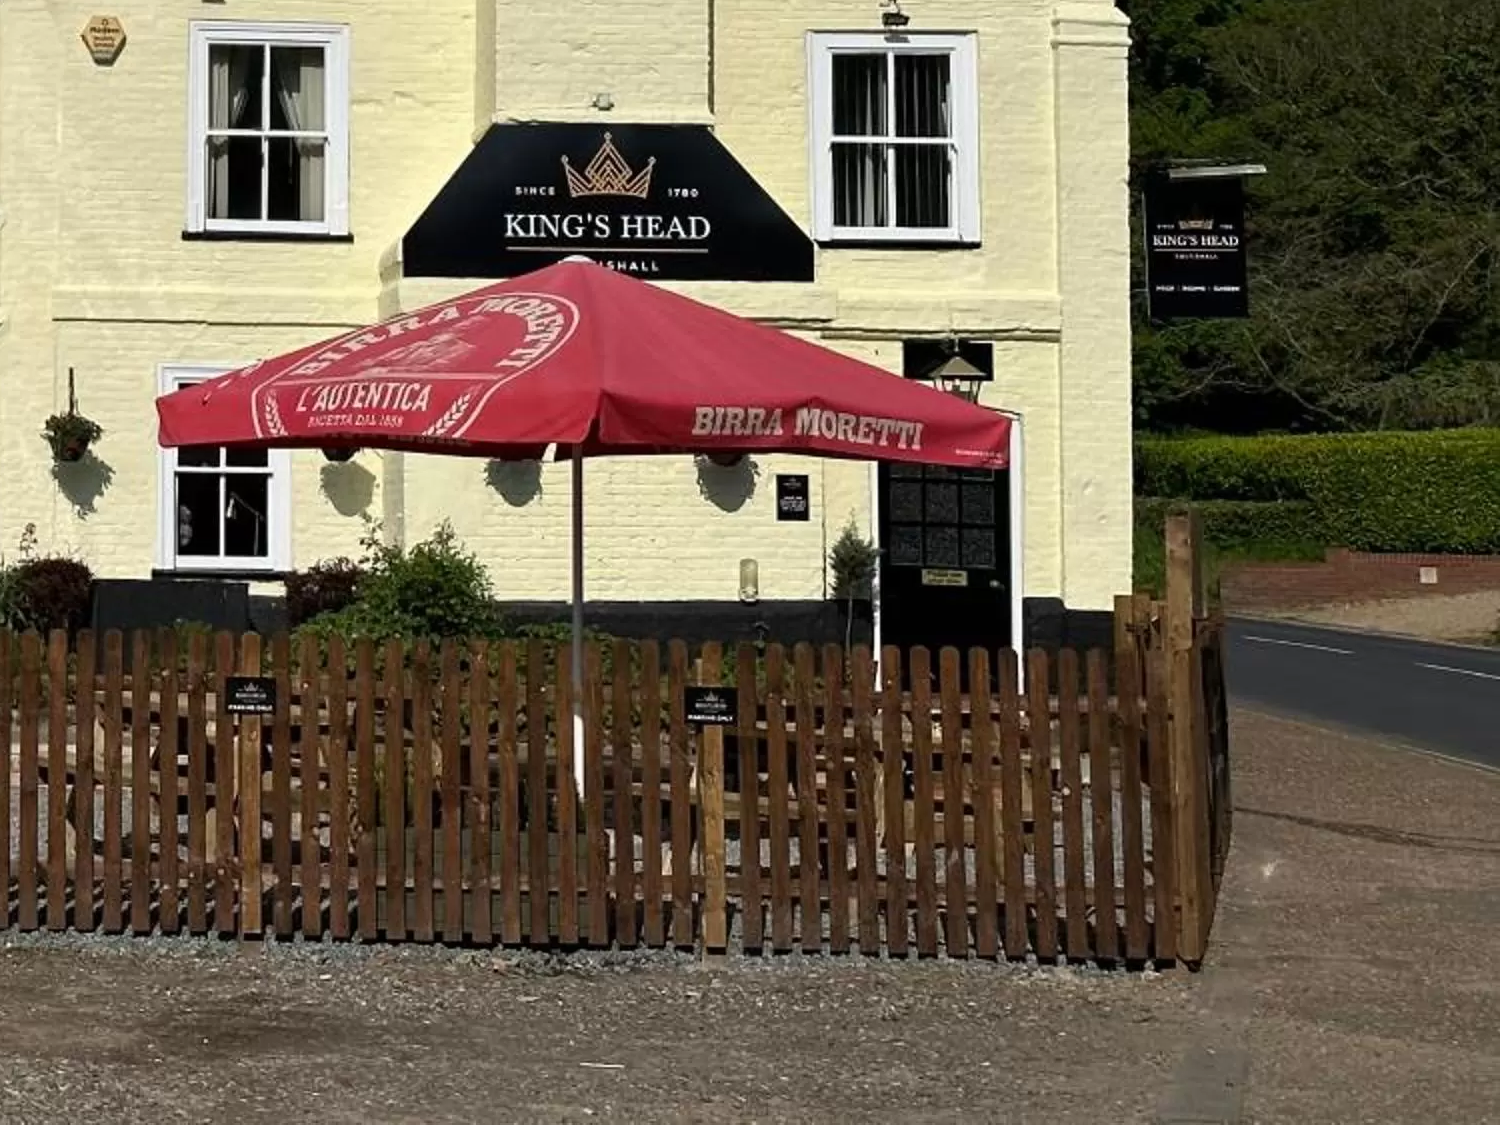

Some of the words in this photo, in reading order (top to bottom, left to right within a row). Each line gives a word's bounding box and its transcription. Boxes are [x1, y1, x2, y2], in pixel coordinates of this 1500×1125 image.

[515, 185, 556, 197] SINCE
[504, 212, 611, 239] KING'S
[620, 215, 711, 241] HEAD
[1152, 233, 1199, 246] KING'S
[1201, 234, 1240, 247] HEAD
[290, 305, 461, 375] BIRRA
[296, 381, 432, 412] L'AUTENTICA
[691, 406, 783, 436] BIRRA
[795, 407, 925, 451] MORETTI
